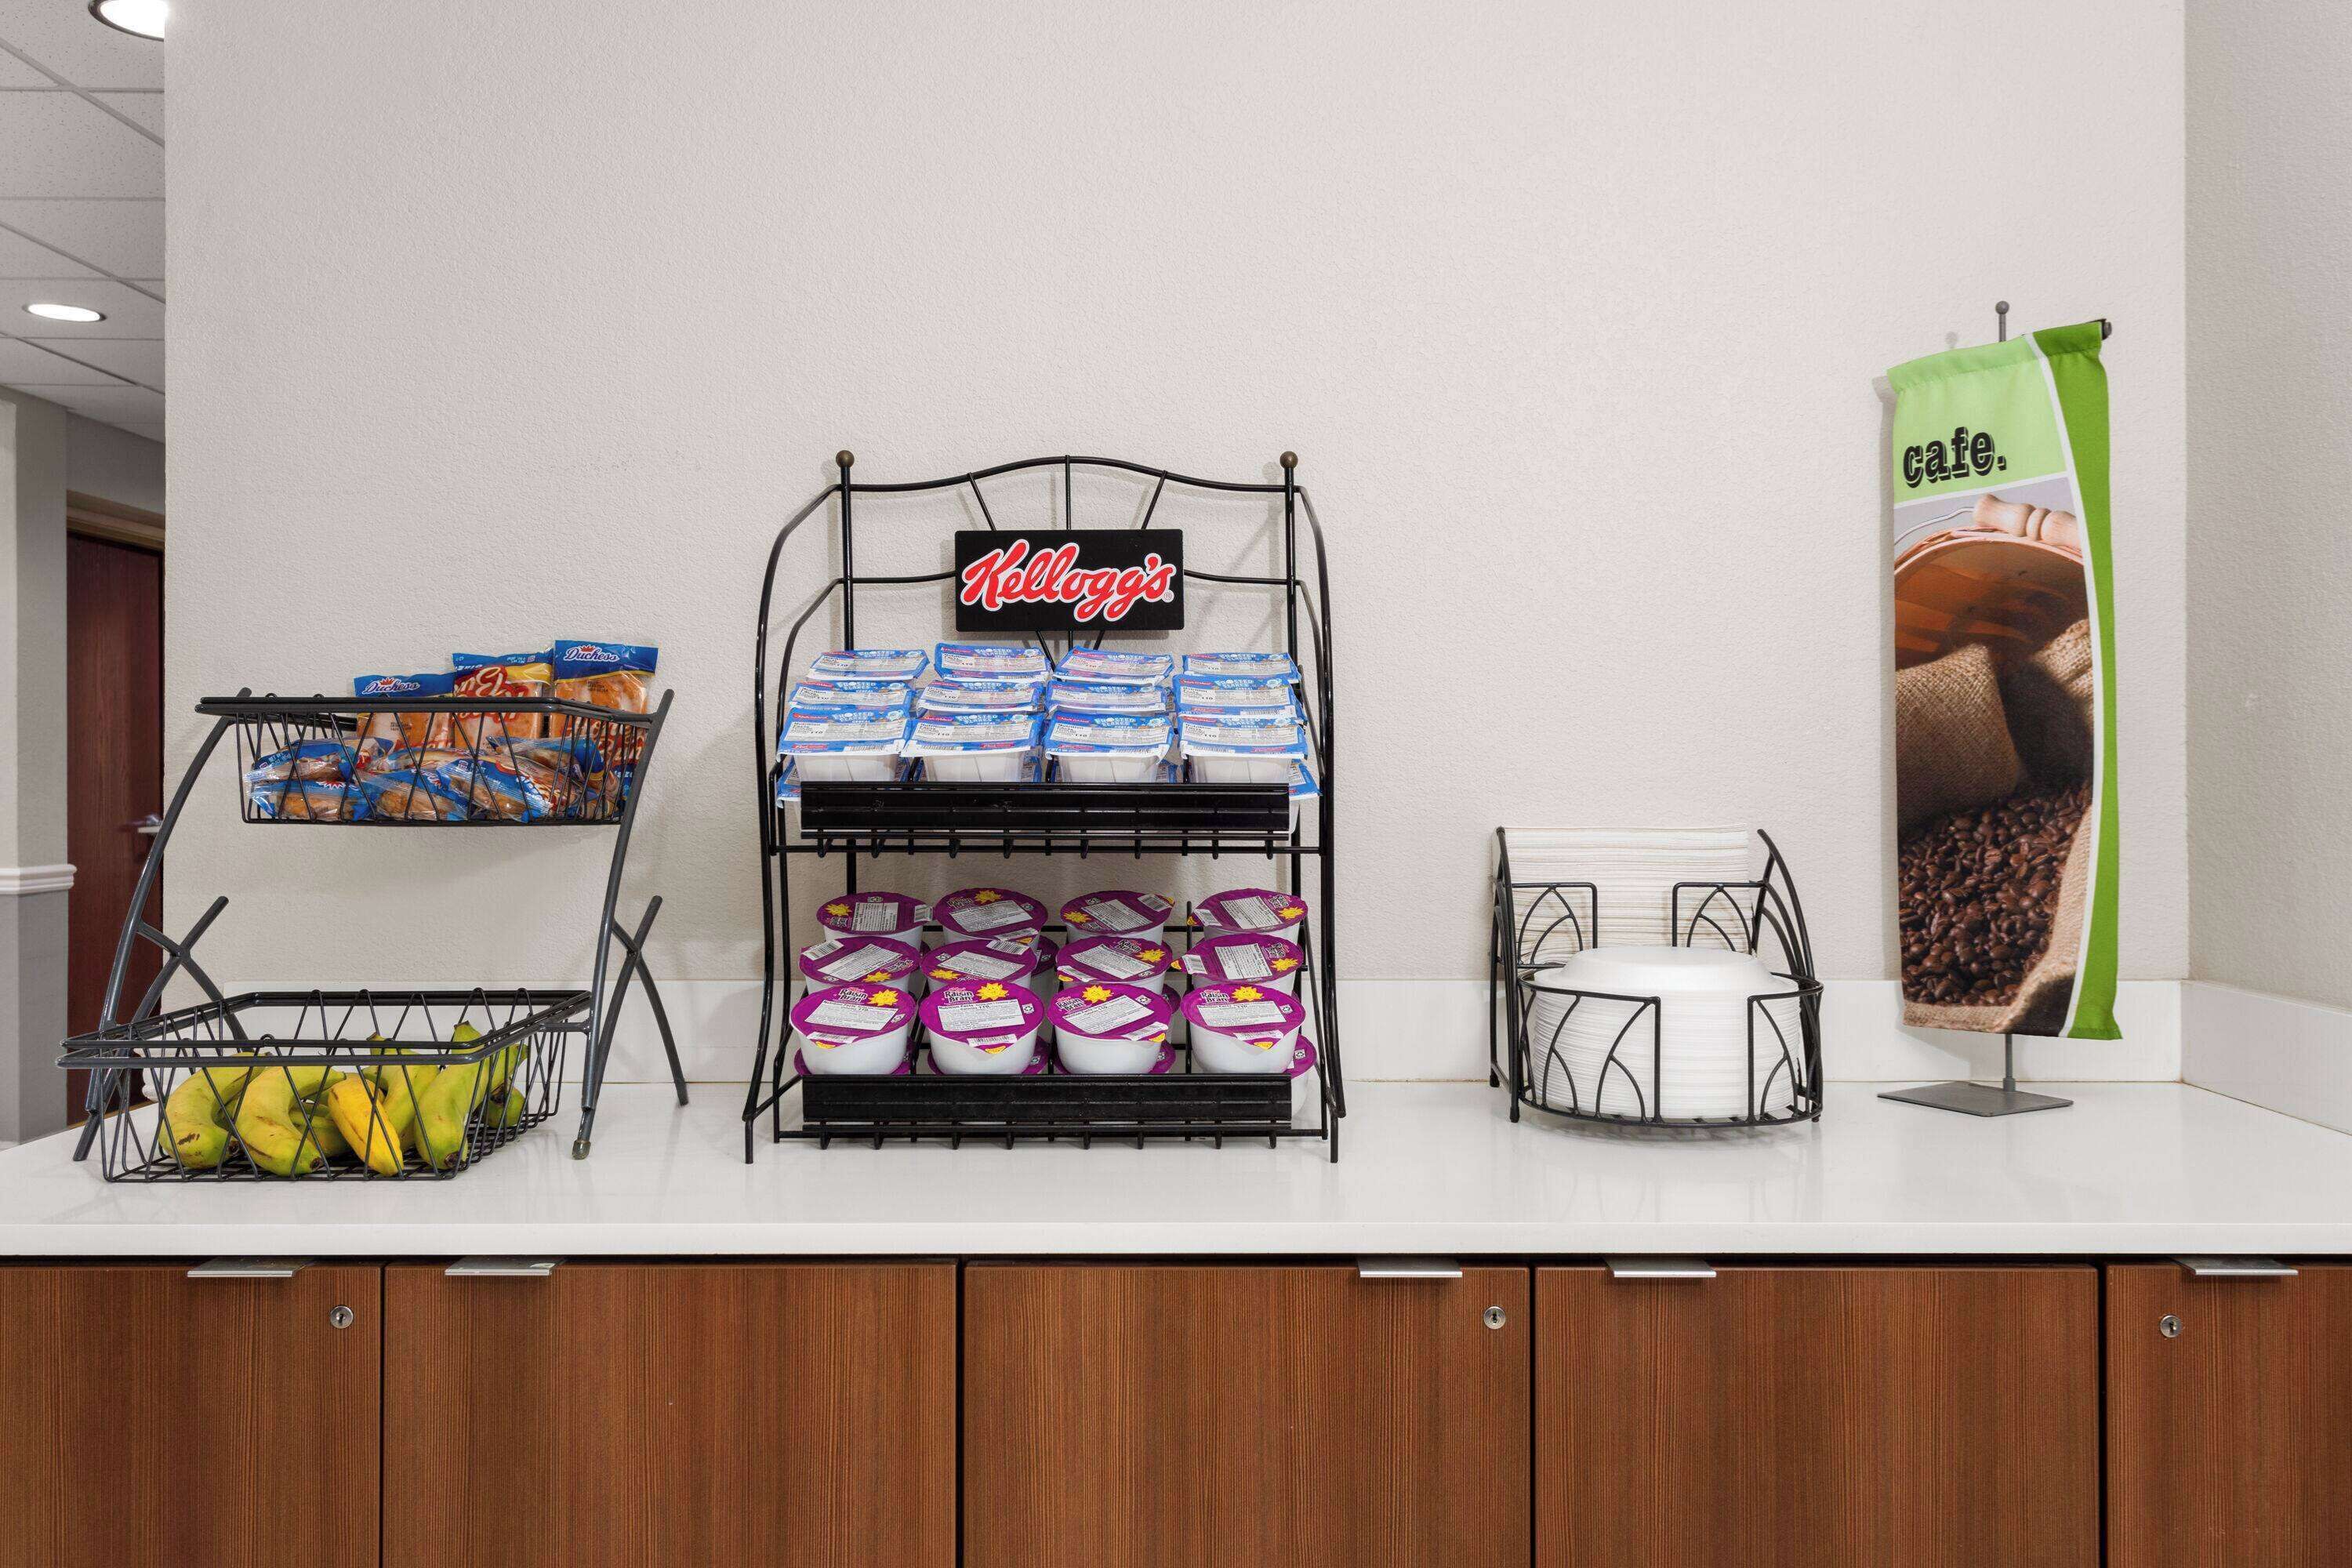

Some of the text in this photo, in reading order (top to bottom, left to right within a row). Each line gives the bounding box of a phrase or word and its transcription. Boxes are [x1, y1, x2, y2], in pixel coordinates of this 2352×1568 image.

[1903, 426, 2007, 488] cafe.
[960, 539, 1176, 622] Kellogg's
[564, 646, 619, 662] Duchess
[362, 679, 420, 694] Duchess
